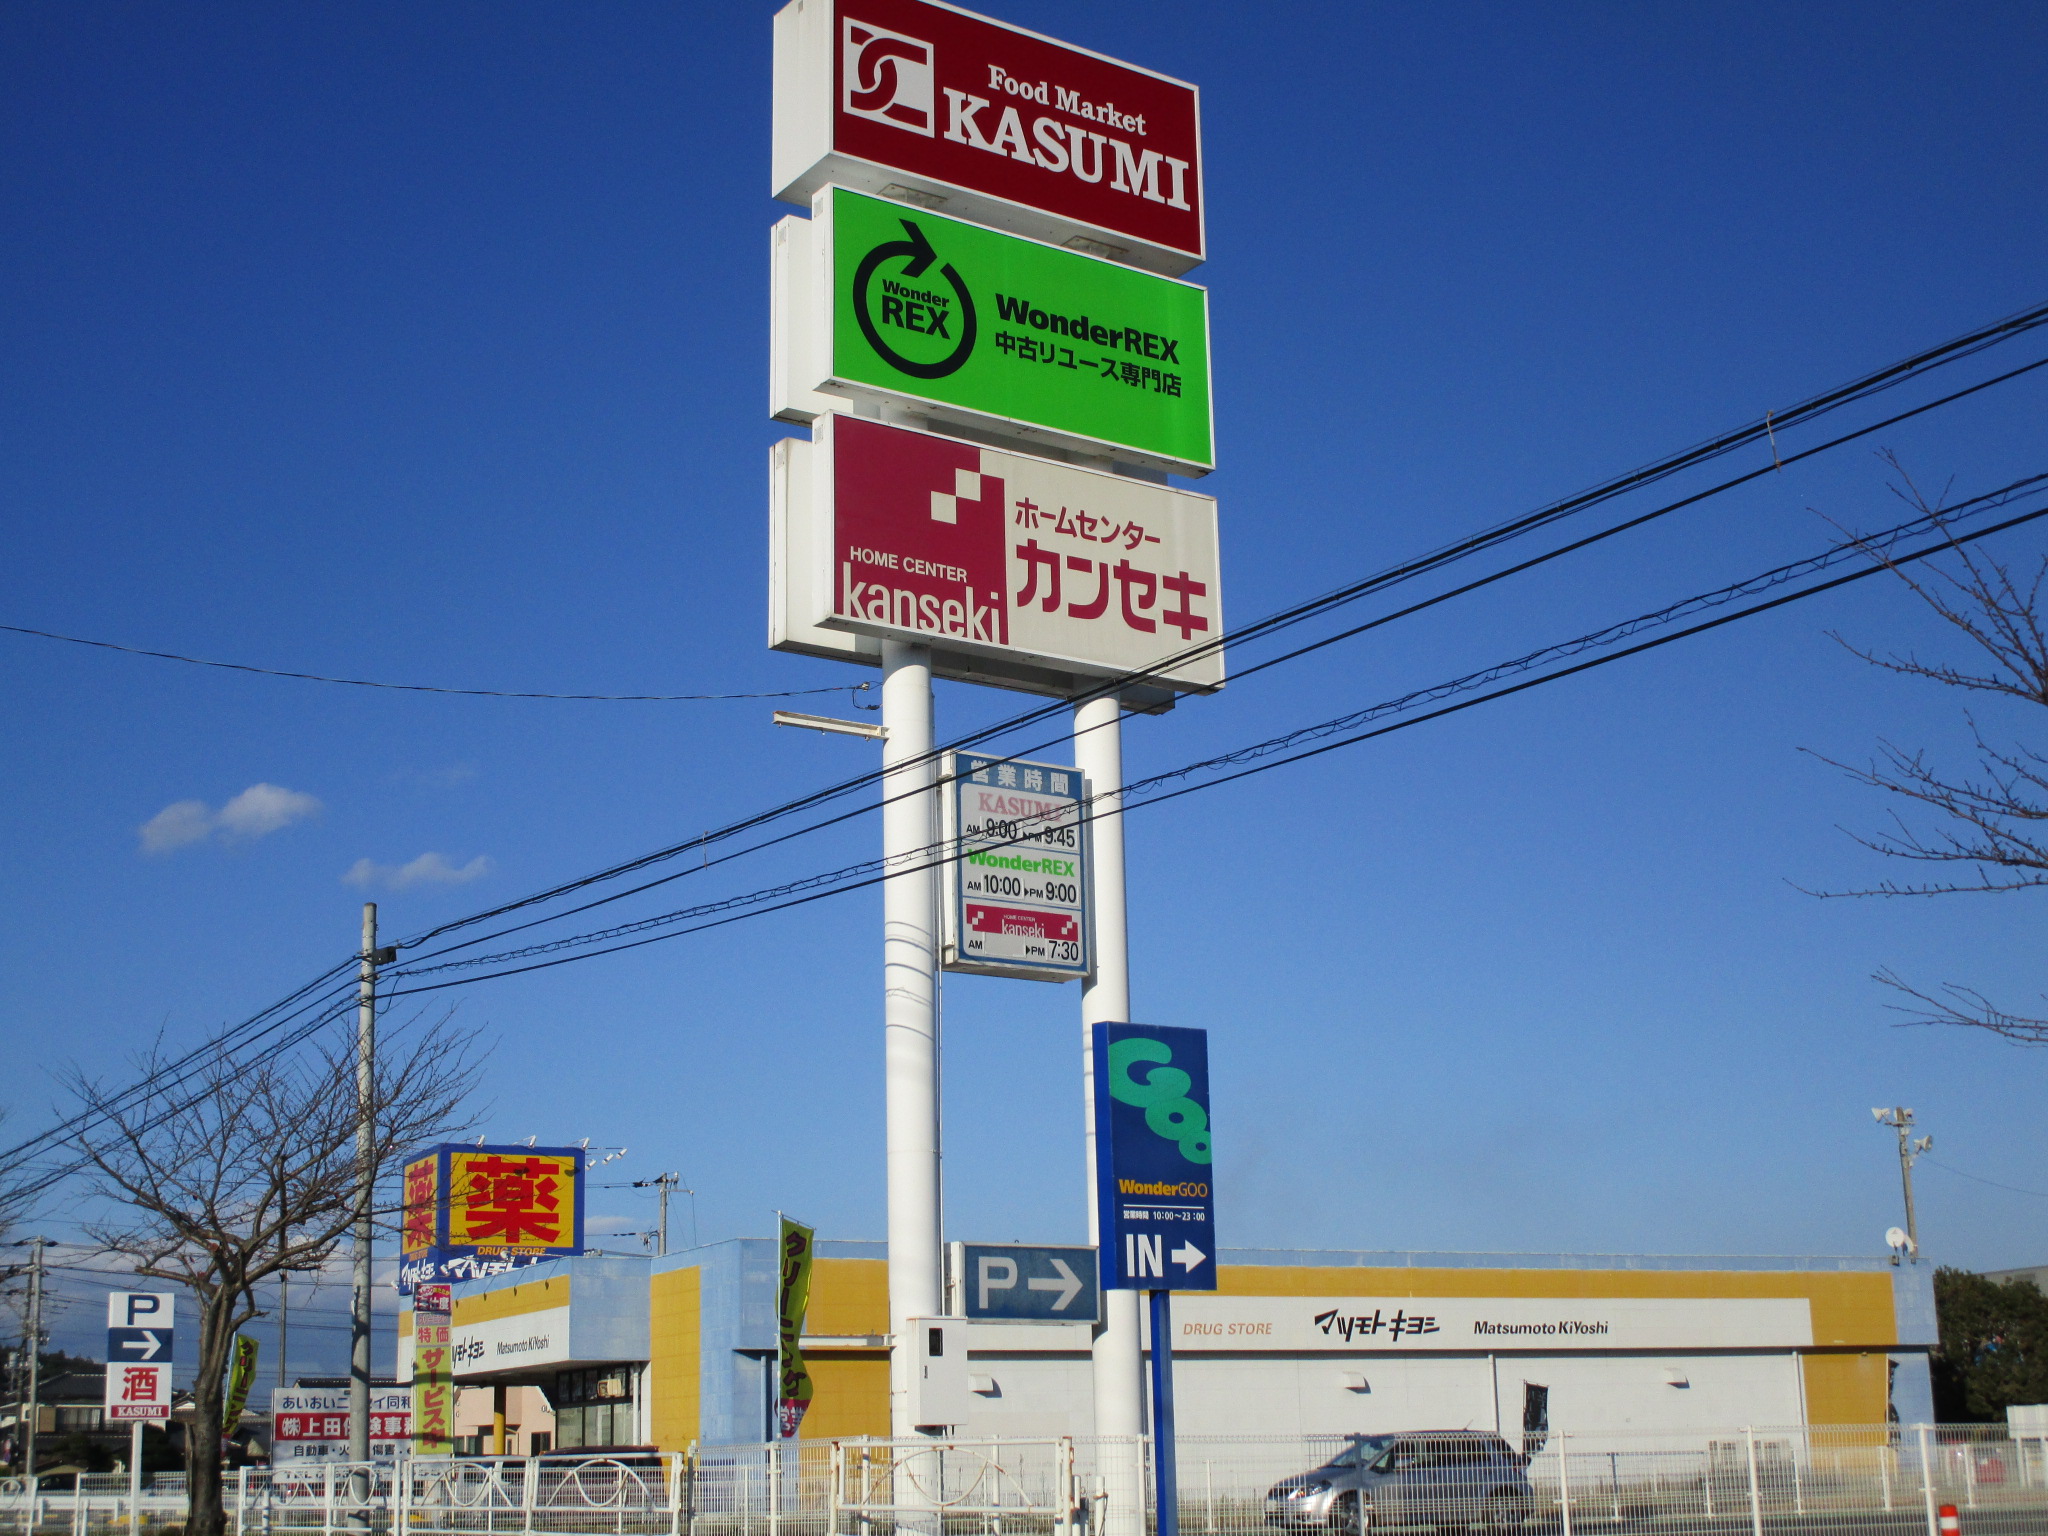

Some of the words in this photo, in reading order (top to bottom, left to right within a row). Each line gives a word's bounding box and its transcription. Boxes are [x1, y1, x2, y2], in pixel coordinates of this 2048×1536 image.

[988, 64, 1050, 106] Food
[1055, 86, 1147, 136] Market
[943, 87, 1191, 211] KASUMI
[882, 279, 950, 308] Wonder
[882, 295, 951, 340] REX
[995, 293, 1180, 365] WonderREX
[995, 331, 1182, 398] 中古リユース専門店
[1015, 496, 1161, 550] ホームセンター
[850, 546, 899, 570] HOME
[903, 557, 968, 583] CENTER
[843, 561, 999, 643] kanseki
[1016, 538, 1208, 640] カンセキ
[970, 759, 1069, 795] 営業時間
[978, 792, 1063, 822] KASUMI
[966, 824, 981, 835] AM
[986, 818, 1018, 840] 9:00
[1028, 832, 1042, 842] PM
[1045, 826, 1076, 847] 9:45
[967, 848, 1075, 877] WonderREX
[967, 880, 982, 891] AM
[984, 874, 1021, 896] 10:00
[1030, 888, 1044, 898] PM
[1046, 881, 1077, 903] 9:00
[1002, 919, 1045, 938] kanseki
[968, 939, 983, 950] AM
[1031, 946, 1045, 956] PM
[1049, 940, 1079, 961] 7:30
[466, 1156, 561, 1243] 薬
[1118, 1179, 1208, 1197] WonderGOO
[477, 1246, 508, 1256] DRUG
[510, 1246, 546, 1257] STORE
[1126, 1233, 1163, 1277] IN
[978, 1255, 1018, 1309] P
[128, 1294, 160, 1325] P
[1314, 1308, 1441, 1342] マツモトキヨシ
[418, 1326, 449, 1343] 特価
[1183, 1322, 1223, 1335] DRUG
[1228, 1322, 1272, 1335] STORE
[1474, 1320, 1556, 1335] Matsumoto
[1558, 1319, 1609, 1335] KiYoshi
[496, 1340, 527, 1356] Matsumoto
[528, 1334, 550, 1352] KiYoshi
[122, 1366, 159, 1402] 酒
[117, 1406, 163, 1418] KASUMI
[282, 1395, 412, 1409] あいおいニイ同和
